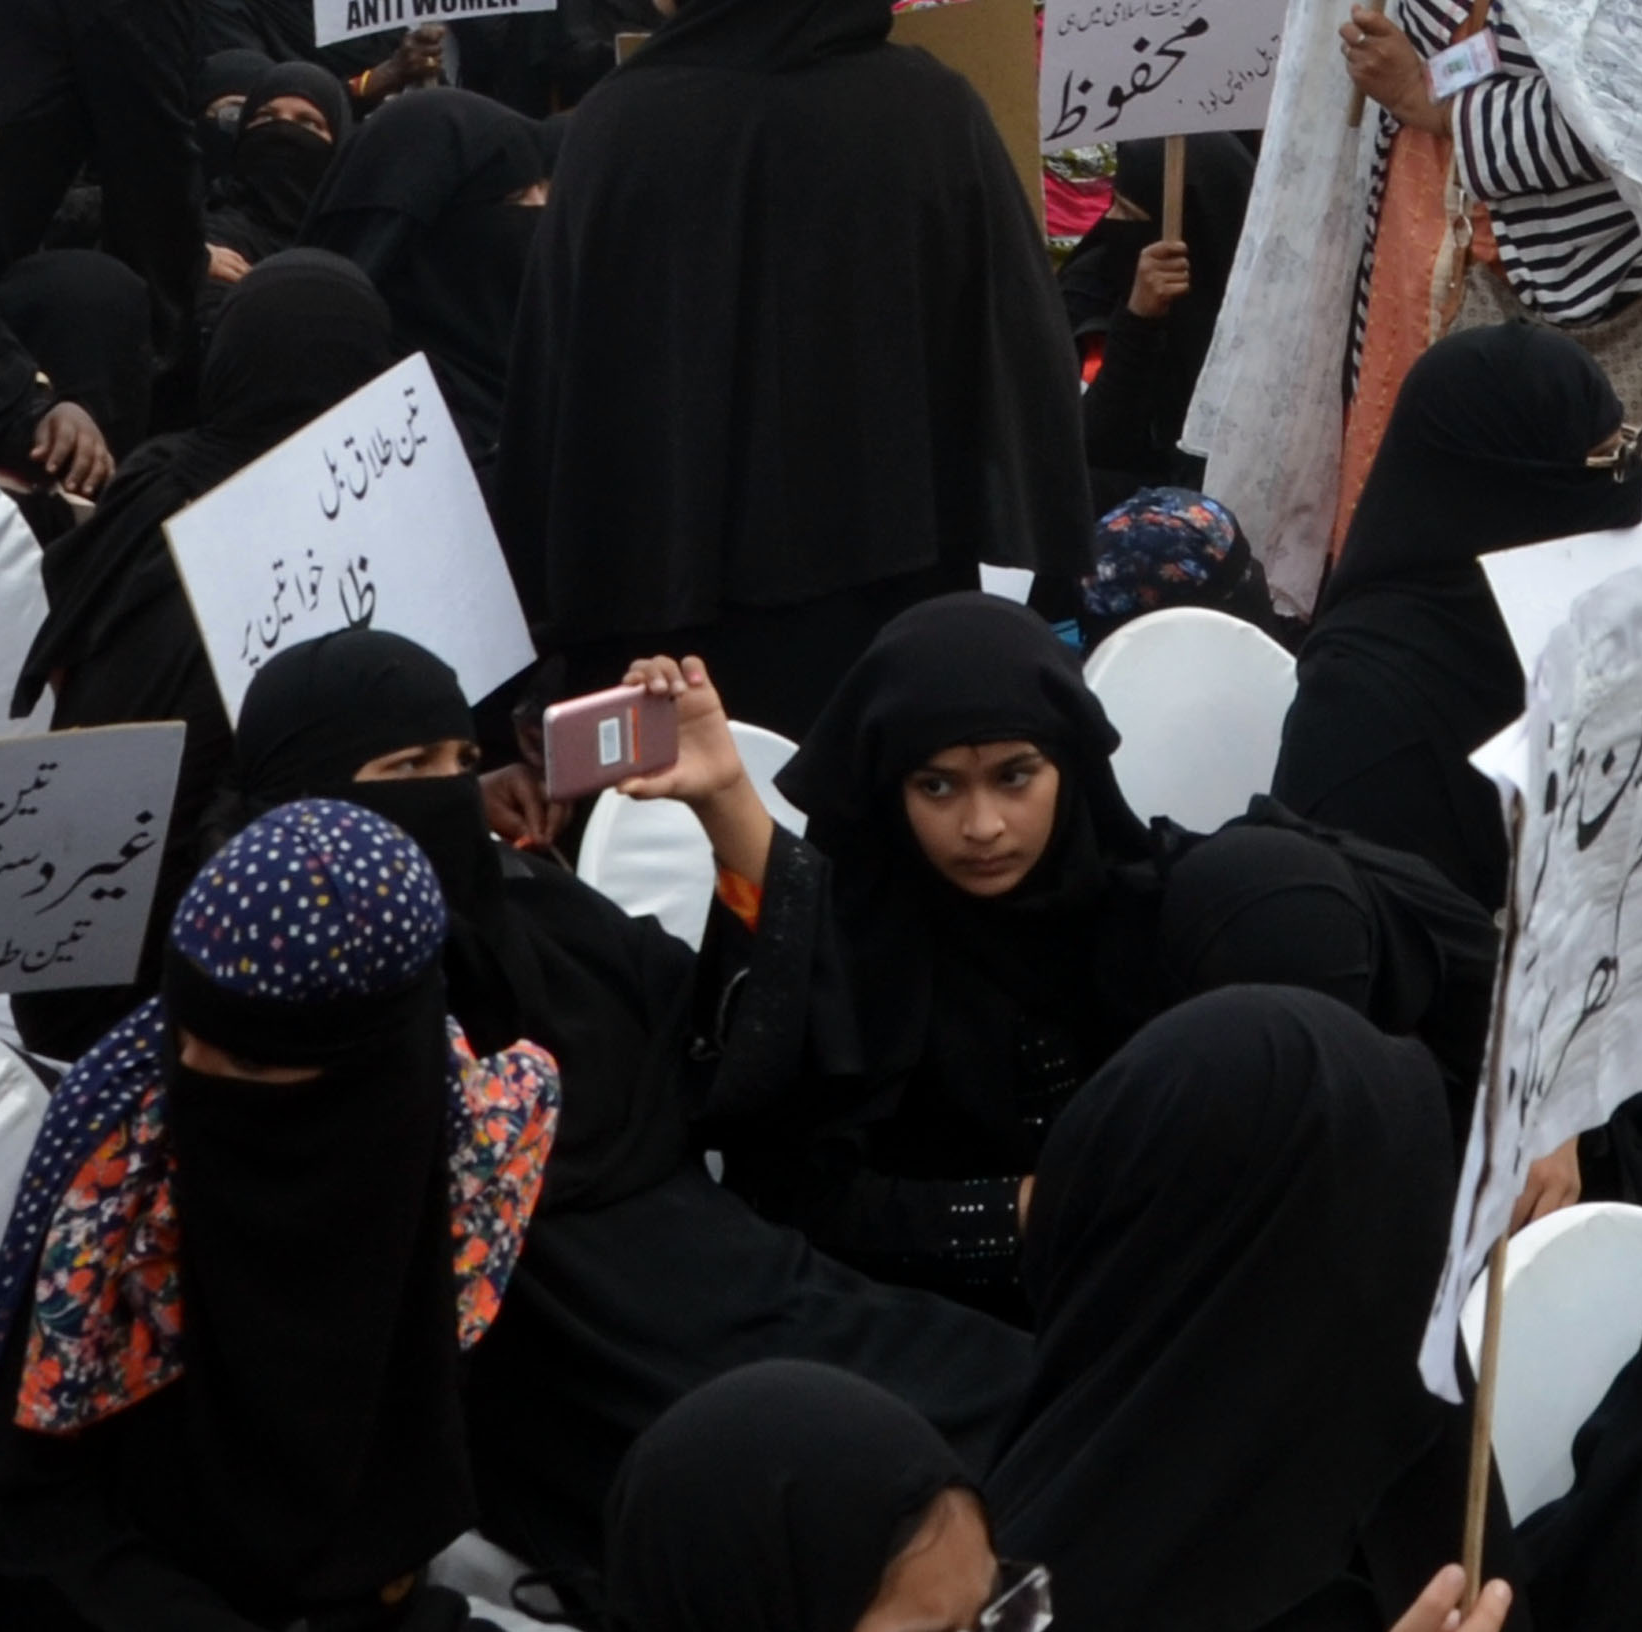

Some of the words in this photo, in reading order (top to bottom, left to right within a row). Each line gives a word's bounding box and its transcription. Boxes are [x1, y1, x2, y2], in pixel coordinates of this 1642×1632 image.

[1044, 17, 1210, 142] محفوظ
[34, 809, 157, 917] غیر
[22, 920, 92, 973] تین
